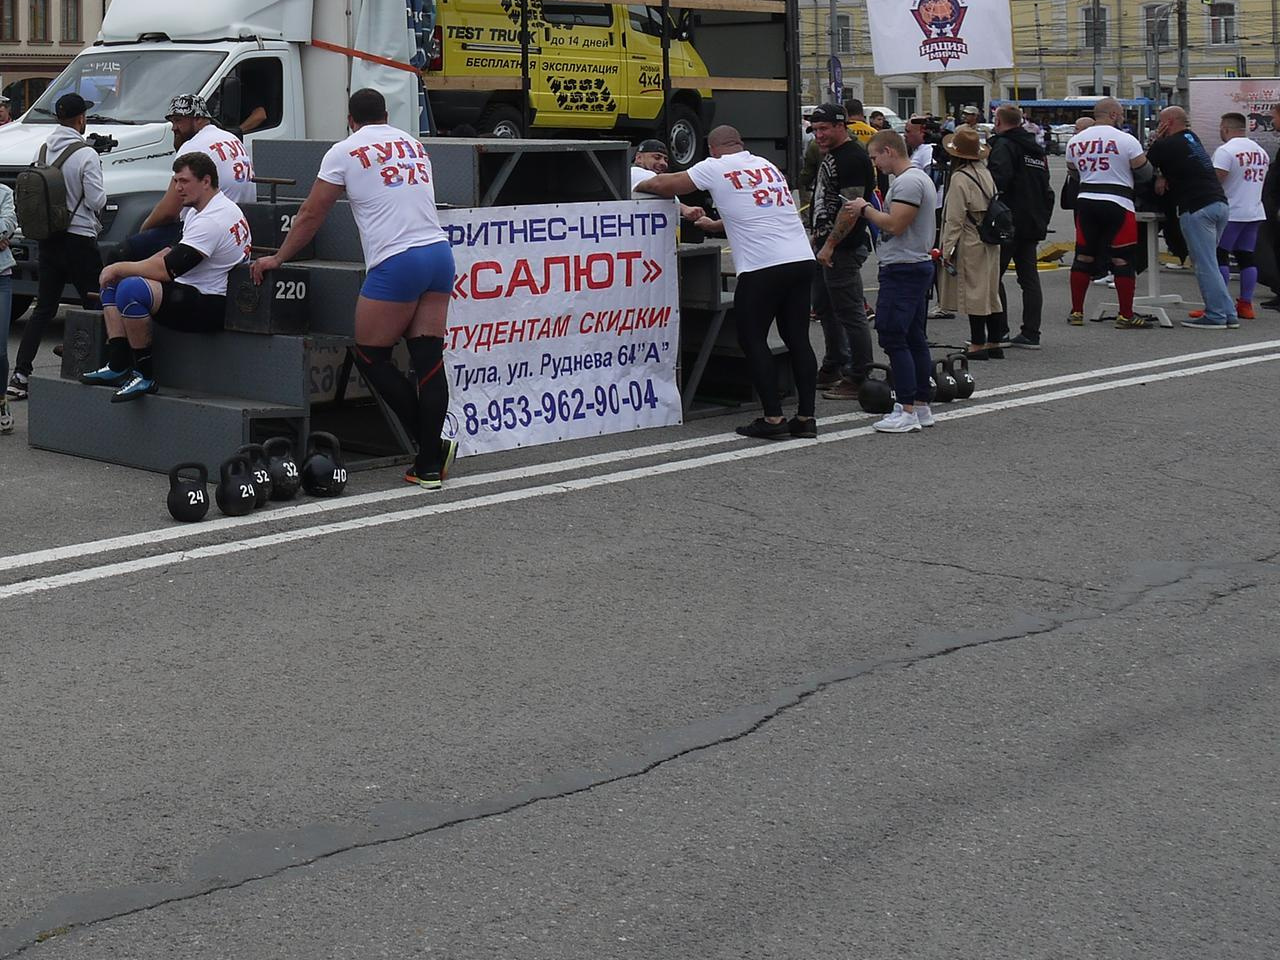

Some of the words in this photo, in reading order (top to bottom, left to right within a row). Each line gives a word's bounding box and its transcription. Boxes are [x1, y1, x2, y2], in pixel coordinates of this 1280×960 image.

[447, 26, 485, 40] TEST
[550, 36, 565, 46] до
[569, 36, 579, 45] 14
[582, 37, 609, 49] дней
[921, 42, 967, 55] НАЦИЯ
[930, 51, 959, 59] МИРА
[466, 57, 536, 70] БЕСПЛАТНЯ
[542, 62, 618, 74] ЭКСПЛУАТАЦИЯ
[349, 136, 432, 170] ТУЛА
[1069, 138, 1120, 158] ТУЛА
[1077, 157, 1111, 172] 875
[1235, 151, 1269, 167] ТУЛА
[380, 162, 430, 188] 875
[724, 164, 786, 190] ТУЛ
[1244, 168, 1264, 182] 875
[442, 212, 669, 247] ФИТНЕС-ЦЕНТР
[452, 250, 664, 300] «САЛЮТ»
[275, 280, 307, 300] 220
[579, 306, 671, 336] СКИДКИ!
[454, 363, 501, 391] Тула,
[506, 361, 534, 386] ул.
[540, 351, 613, 379] Руднева
[462, 378, 659, 436] 8-953-962-90-04
[253, 470, 270, 484] 32
[282, 461, 299, 477] 32
[333, 468, 348, 483] 40
[188, 489, 205, 505] 24
[239, 483, 256, 498] 24
